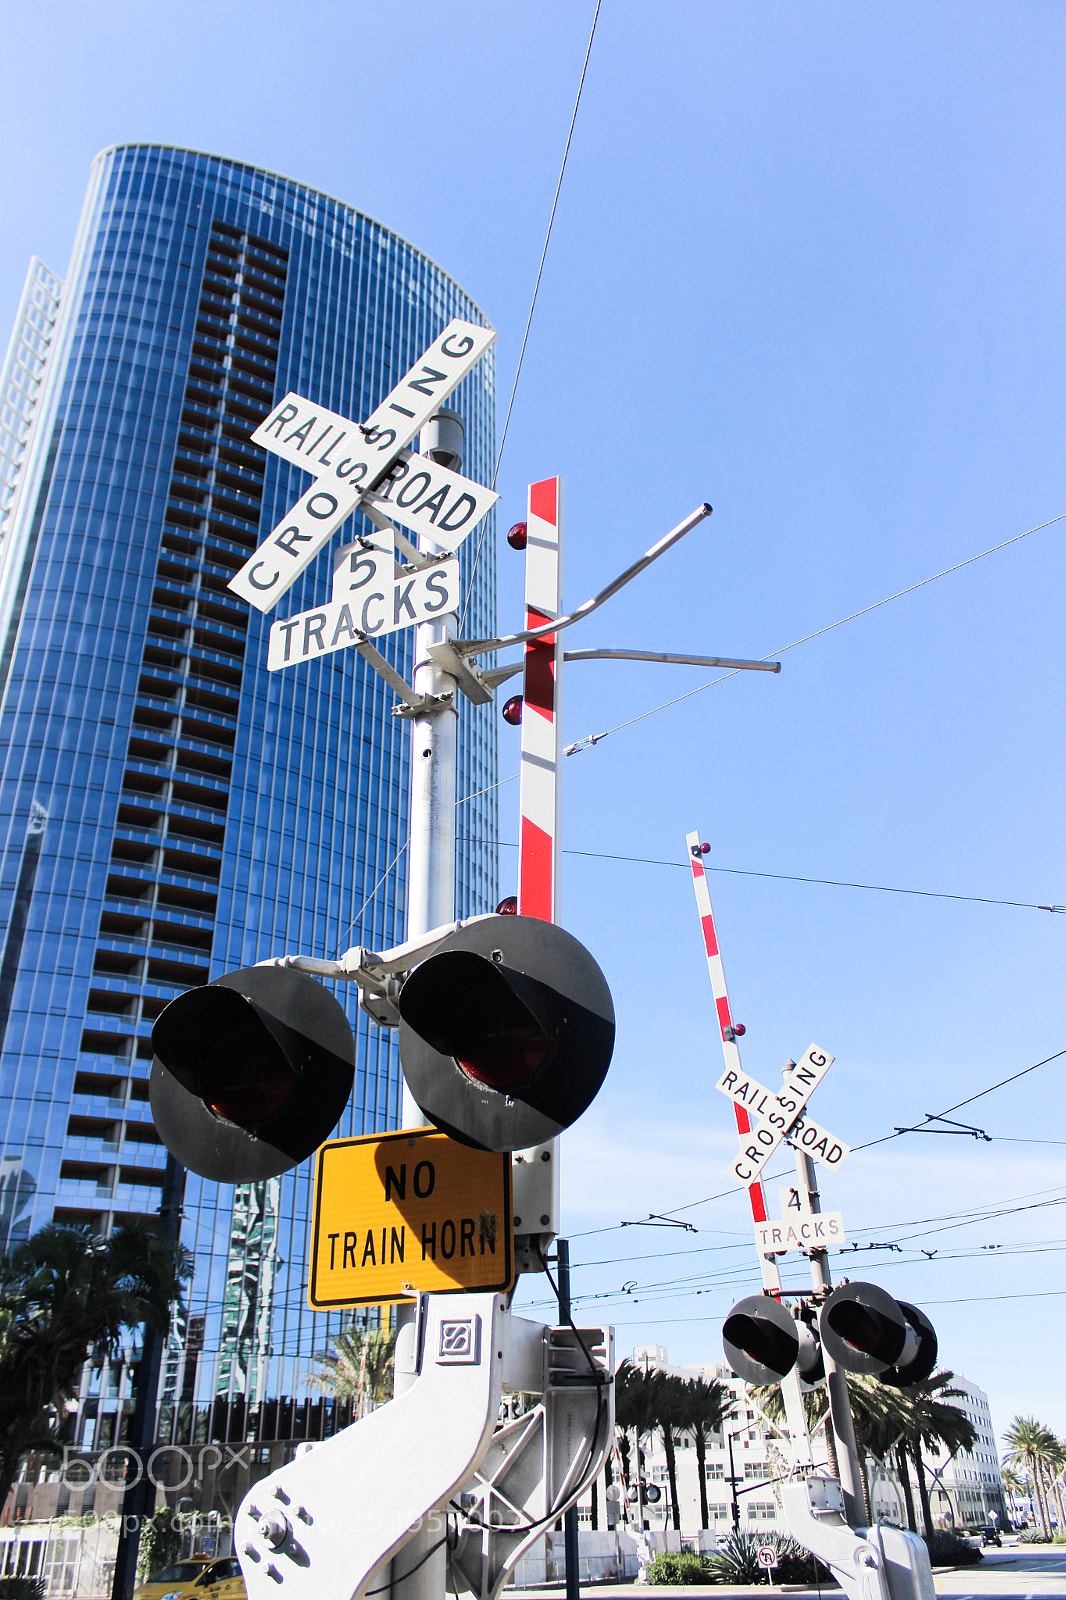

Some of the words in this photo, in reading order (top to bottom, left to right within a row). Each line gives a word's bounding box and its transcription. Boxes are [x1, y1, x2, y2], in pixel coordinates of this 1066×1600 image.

[247, 333, 475, 591] CROSSING
[264, 403, 347, 466] RAIL
[371, 458, 477, 531] ROAD
[349, 548, 377, 591] 5
[279, 569, 449, 662] TRACKS
[721, 1070, 768, 1115] RAIL
[790, 1117, 843, 1165] ROAD
[735, 1051, 826, 1180] CROSSING
[384, 1160, 436, 1202] NO
[787, 1188, 801, 1211] 4
[328, 1225, 405, 1270] TRAIN
[421, 1214, 496, 1261] HORN
[759, 1219, 839, 1245] TRACKS
